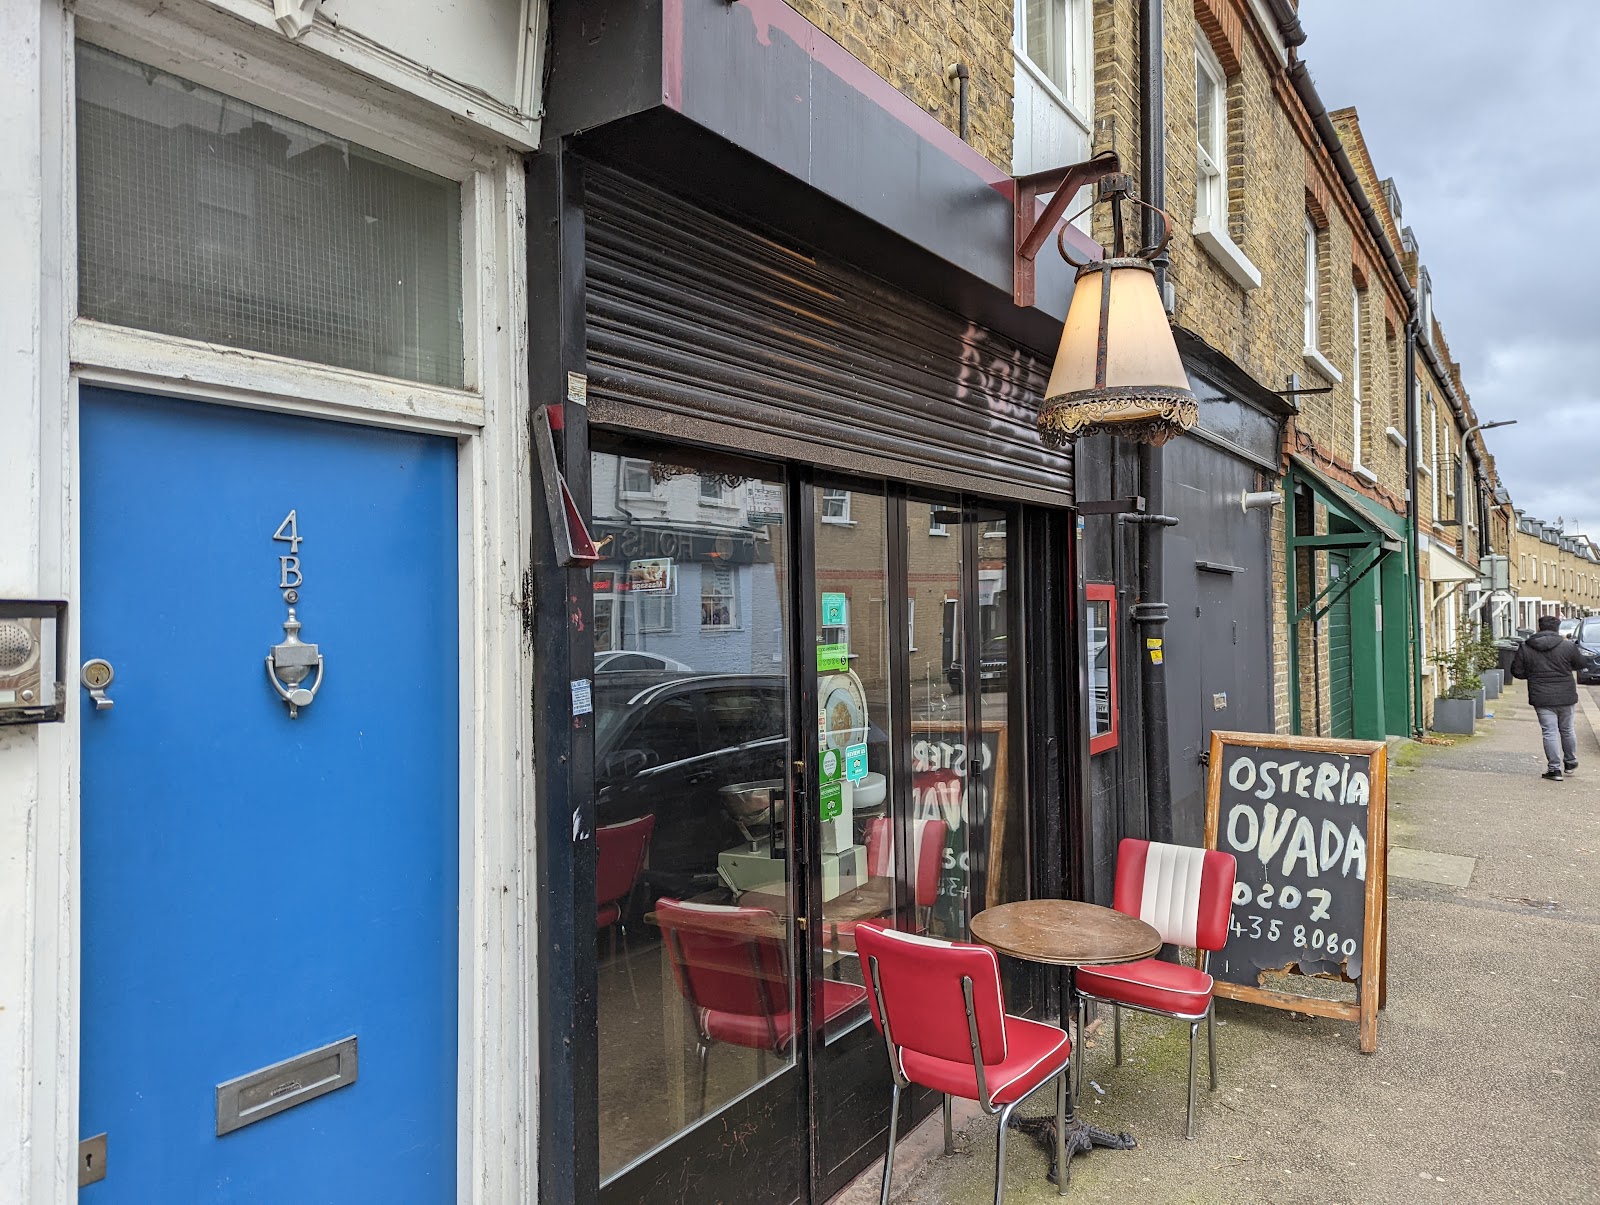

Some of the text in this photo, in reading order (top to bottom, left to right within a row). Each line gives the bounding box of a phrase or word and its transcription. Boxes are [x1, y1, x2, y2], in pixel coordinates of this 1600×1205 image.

[272, 509, 303, 554] 4
[279, 555, 303, 588] B
[1228, 756, 1370, 806] OSTERIA
[1226, 802, 1367, 881] OVADA
[1231, 881, 1332, 922] 0207
[1229, 913, 1357, 956] 435 8080
